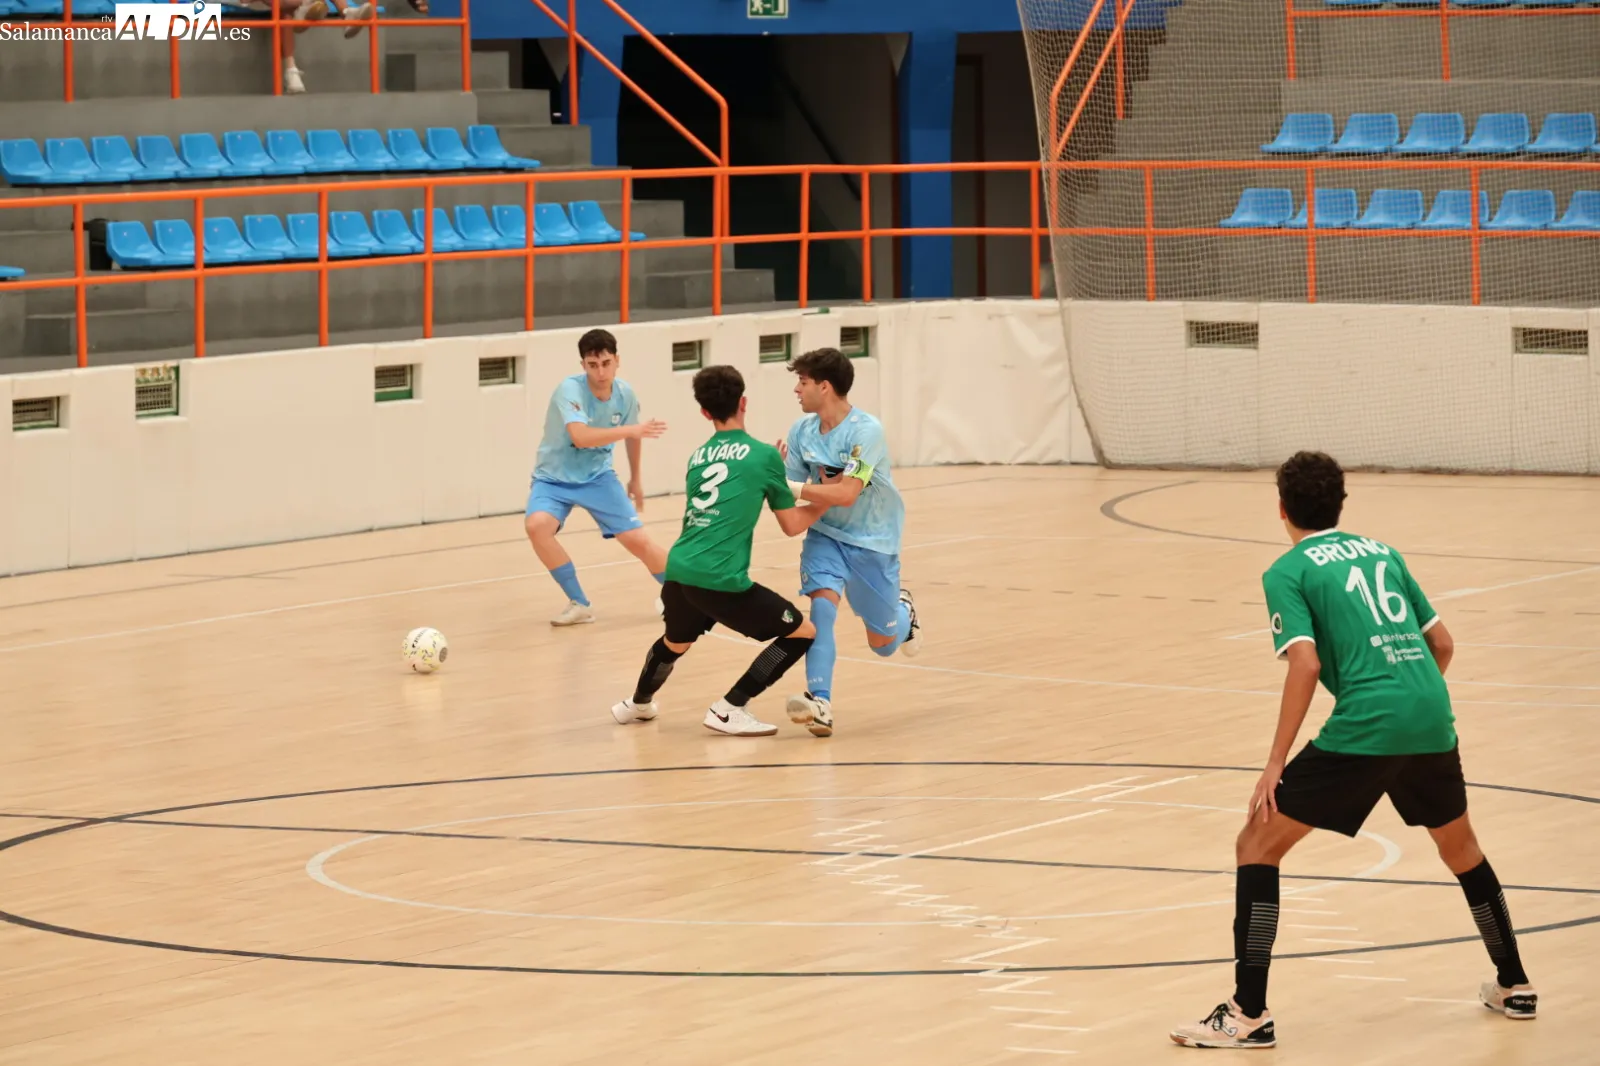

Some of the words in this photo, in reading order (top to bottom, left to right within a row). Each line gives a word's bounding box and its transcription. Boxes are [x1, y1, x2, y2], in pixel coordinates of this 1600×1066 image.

[689, 442, 750, 468] ALVARO
[691, 462, 729, 510] 3
[1304, 537, 1390, 567] BRUNO
[1345, 560, 1407, 626] 16
